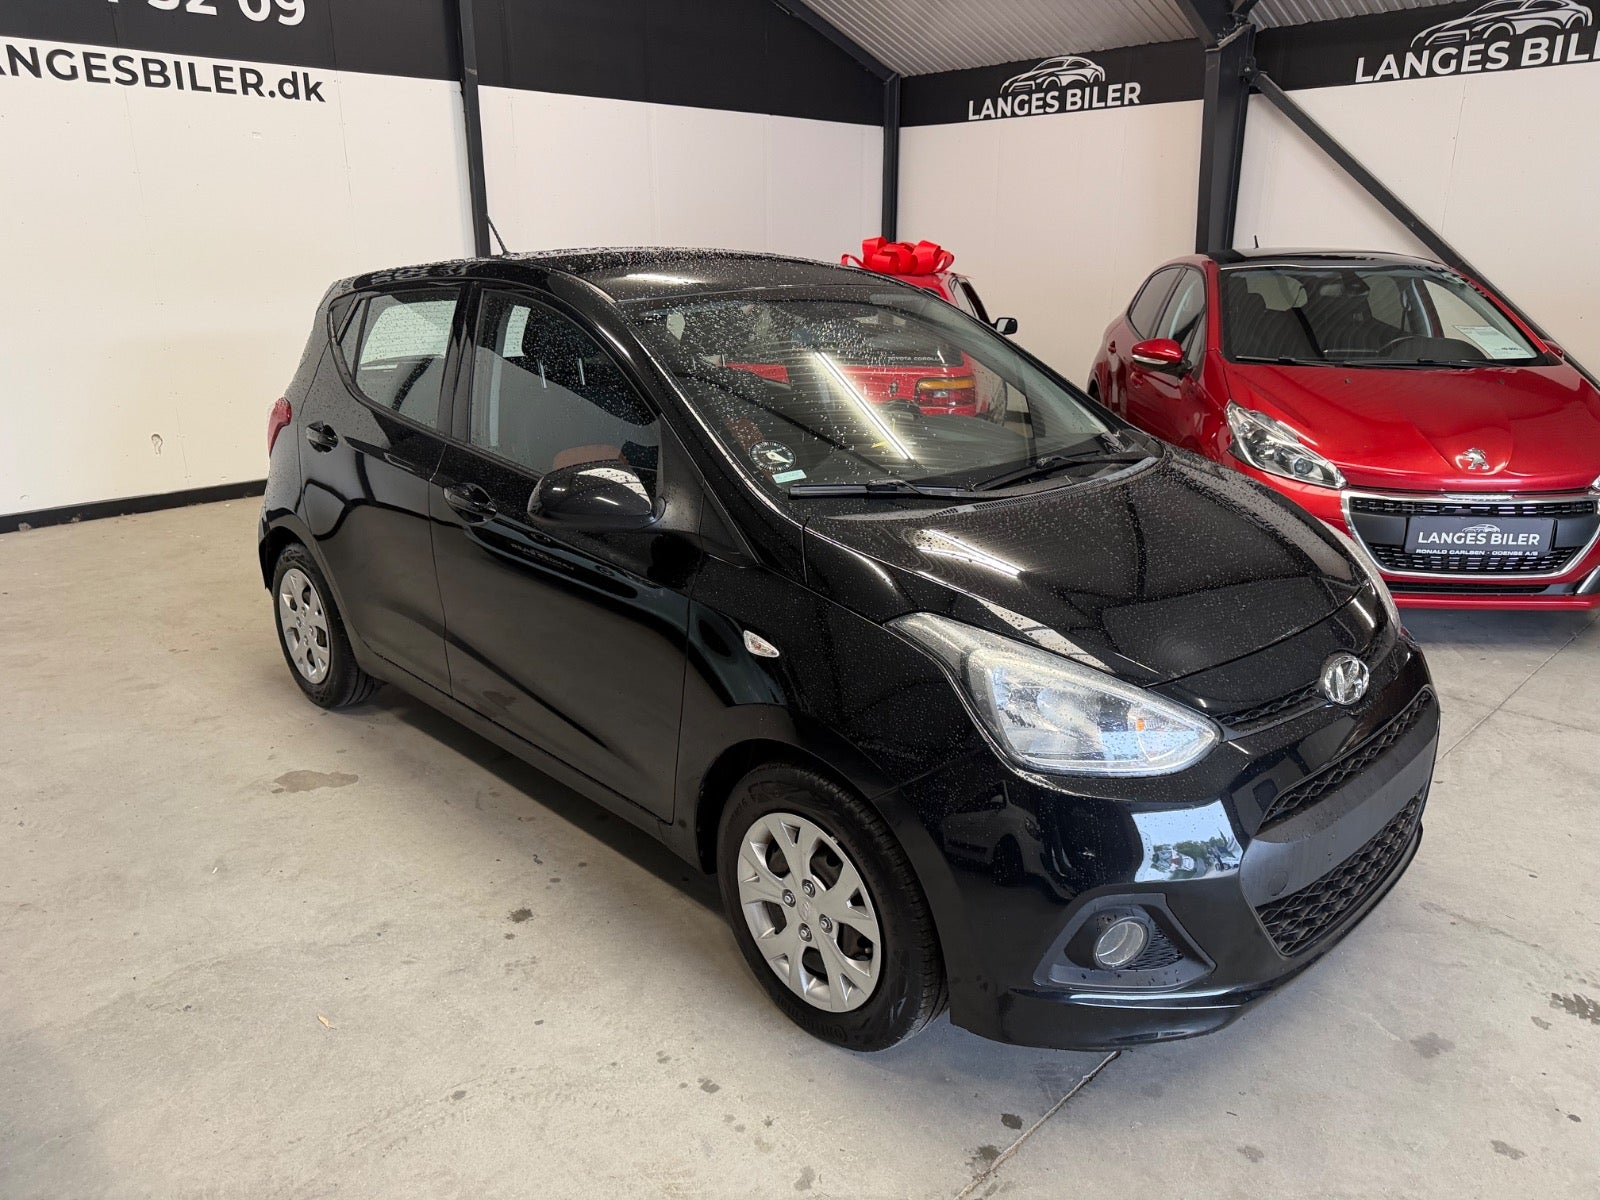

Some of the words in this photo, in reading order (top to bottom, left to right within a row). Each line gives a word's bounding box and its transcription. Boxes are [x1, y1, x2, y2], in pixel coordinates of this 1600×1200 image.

[0, 44, 326, 103] NGESBILER.dk
[1355, 40, 1510, 83] LANGES
[968, 91, 1060, 121] LANGES
[1065, 82, 1142, 110] BILER
[1418, 531, 1487, 545] LANGES
[1490, 533, 1540, 546] BILER
